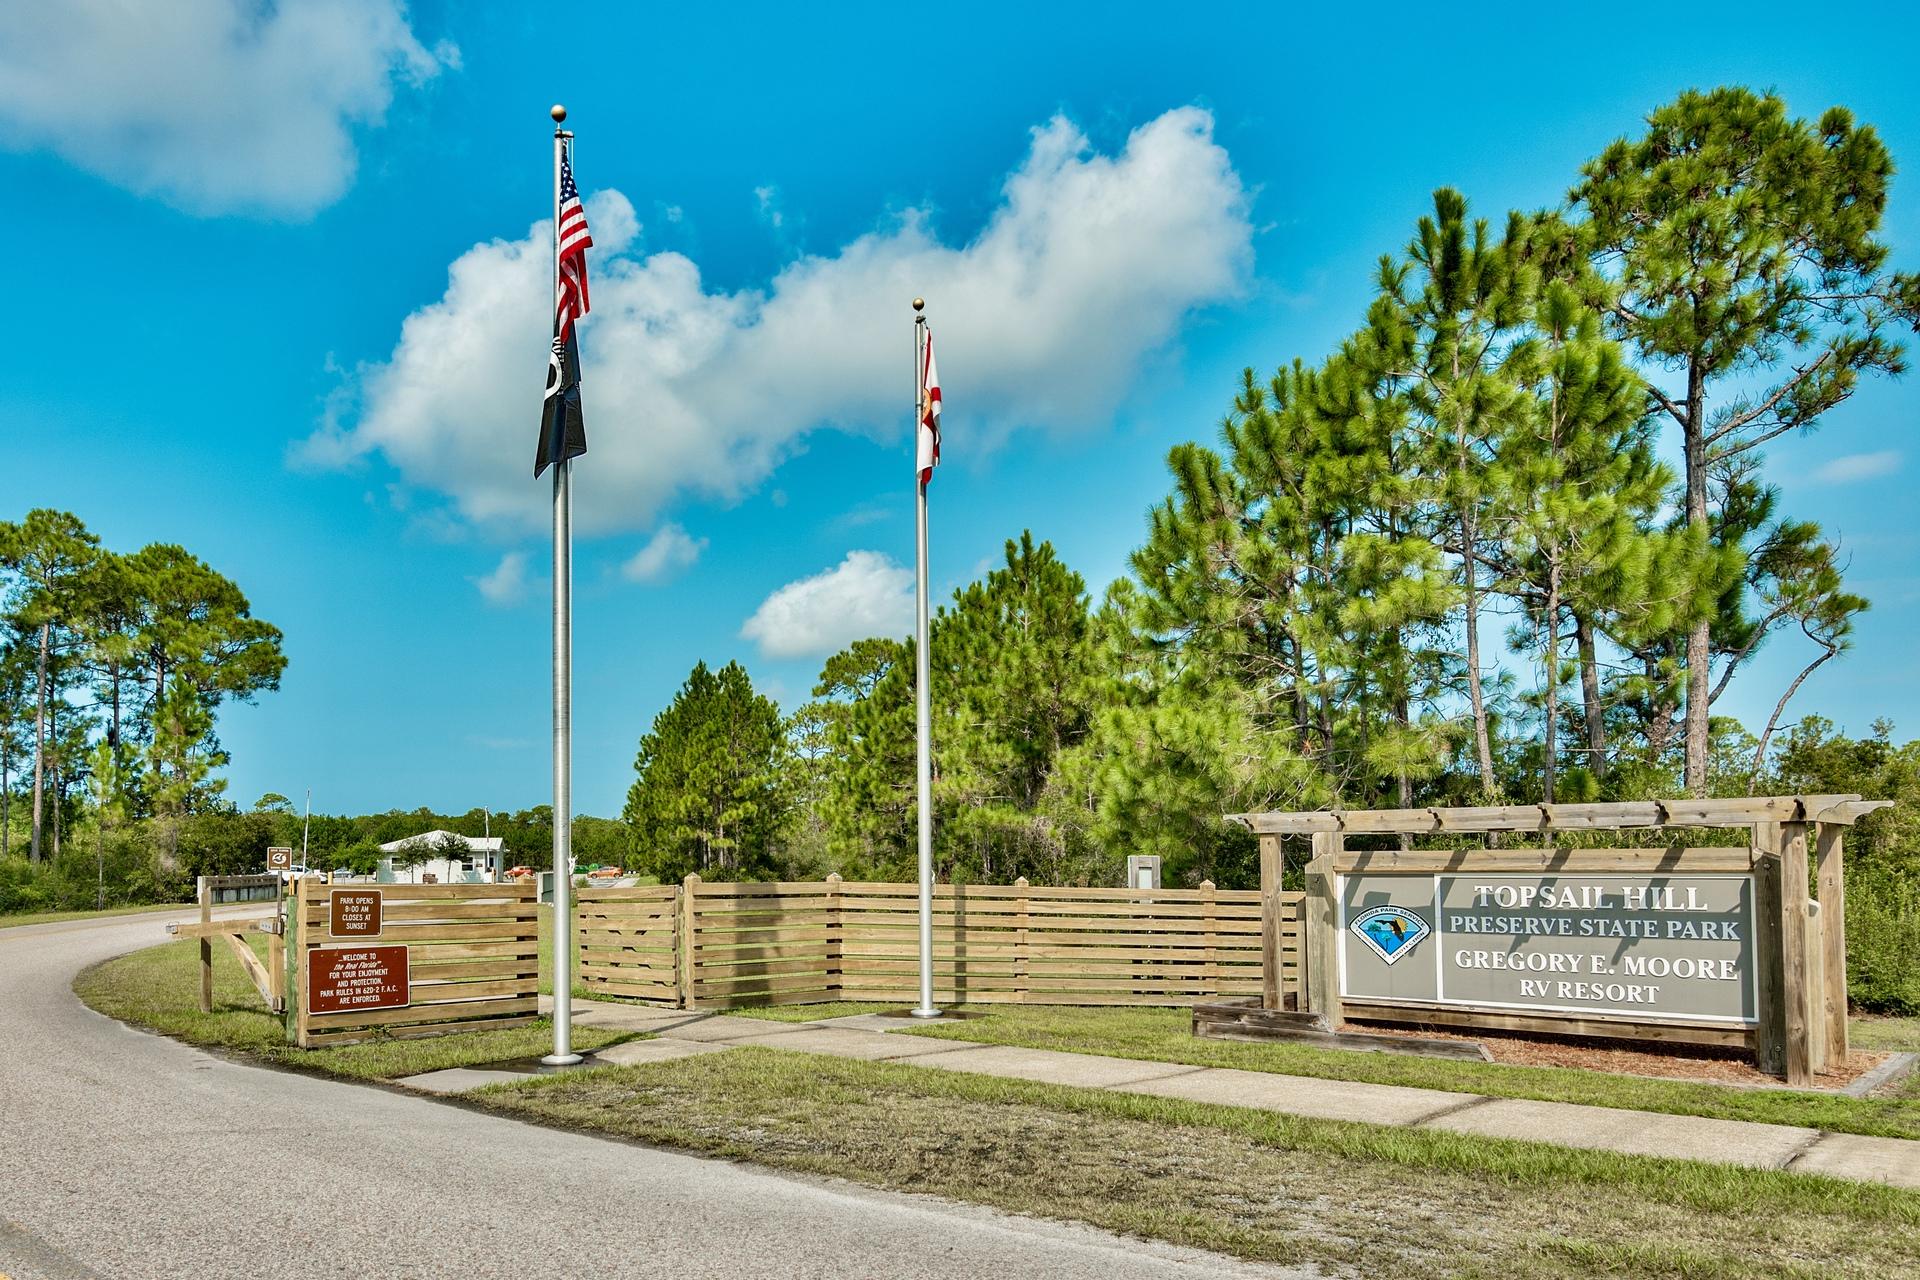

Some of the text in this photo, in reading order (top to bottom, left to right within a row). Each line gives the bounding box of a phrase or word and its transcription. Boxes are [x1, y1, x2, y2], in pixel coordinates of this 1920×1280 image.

[1474, 886, 1708, 911] TOPSAIL HILL
[346, 922, 367, 930] SUNSET
[1355, 909, 1379, 925] FLORIDA
[1400, 910, 1426, 928] SERVICE
[1450, 916, 1740, 940] PRESERVE STATE PARK
[1392, 931, 1425, 959] PROTECTION
[345, 962, 358, 970] Real
[359, 968, 388, 977] ENJOYMENT
[1455, 950, 1738, 980] GREGORY E. MOORE
[1520, 980, 1660, 1004] RV RESORT
